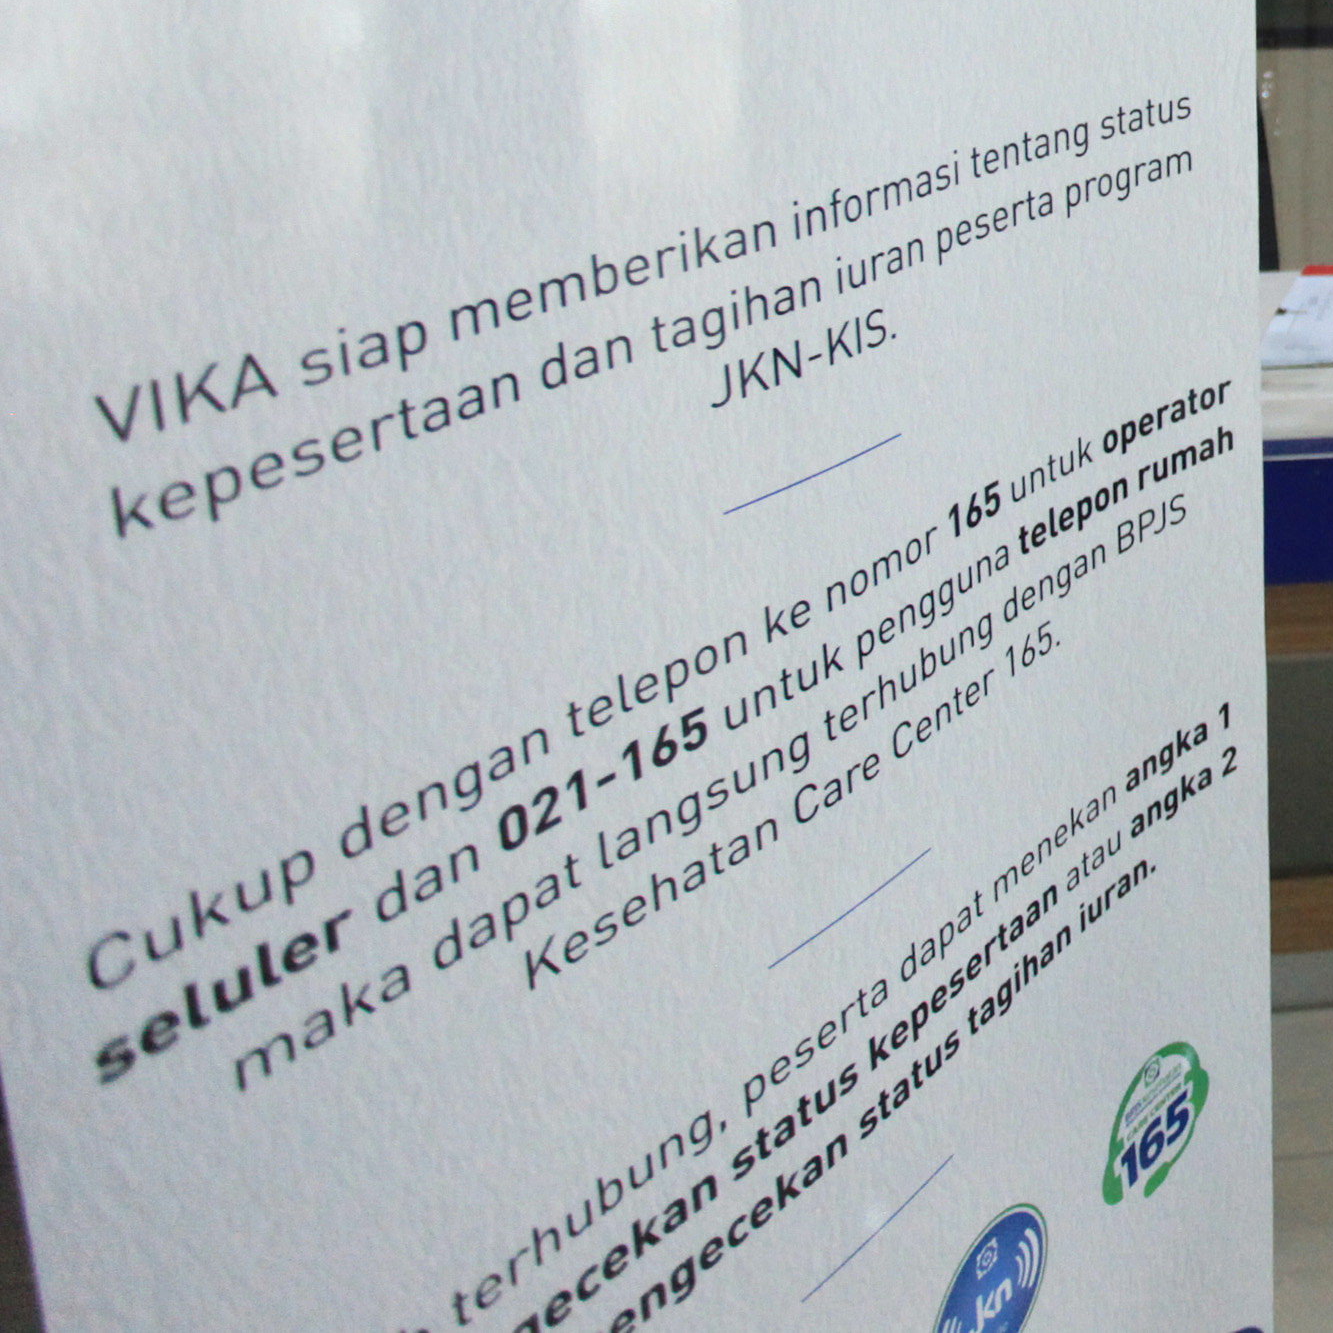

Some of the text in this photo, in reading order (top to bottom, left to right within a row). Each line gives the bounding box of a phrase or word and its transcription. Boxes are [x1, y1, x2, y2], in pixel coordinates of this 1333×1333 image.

[95, 96, 1192, 443] VIKA siap memberikan informasi tentang status
[110, 149, 1194, 539] kepesertaan dan tagihan iuran peserta program
[710, 309, 897, 409] JKN-KIS.
[86, 379, 1232, 990] Cukup dengan telepon ke nomor 165 untuk operator
[95, 426, 1235, 1086] seluler dan 021-165 untuk pengguna telepon rumah
[233, 492, 1188, 1093] maka dapat langsung terhubung dengan BPJS
[524, 619, 1062, 991] Kesehatan Care Center 165.
[452, 702, 1231, 1327] terhubung, peserta dapat menekan angka 1
[731, 1061, 859, 1181] status
[868, 884, 1058, 1071] kepesertaan
[1065, 829, 1122, 893] atau
[1130, 761, 1214, 838] angka
[1222, 745, 1238, 778] 2
[858, 1032, 961, 1140] status
[967, 923, 1072, 1035] tagihan
[1079, 860, 1157, 933] iuran.
[1121, 1088, 1189, 1188] 165
